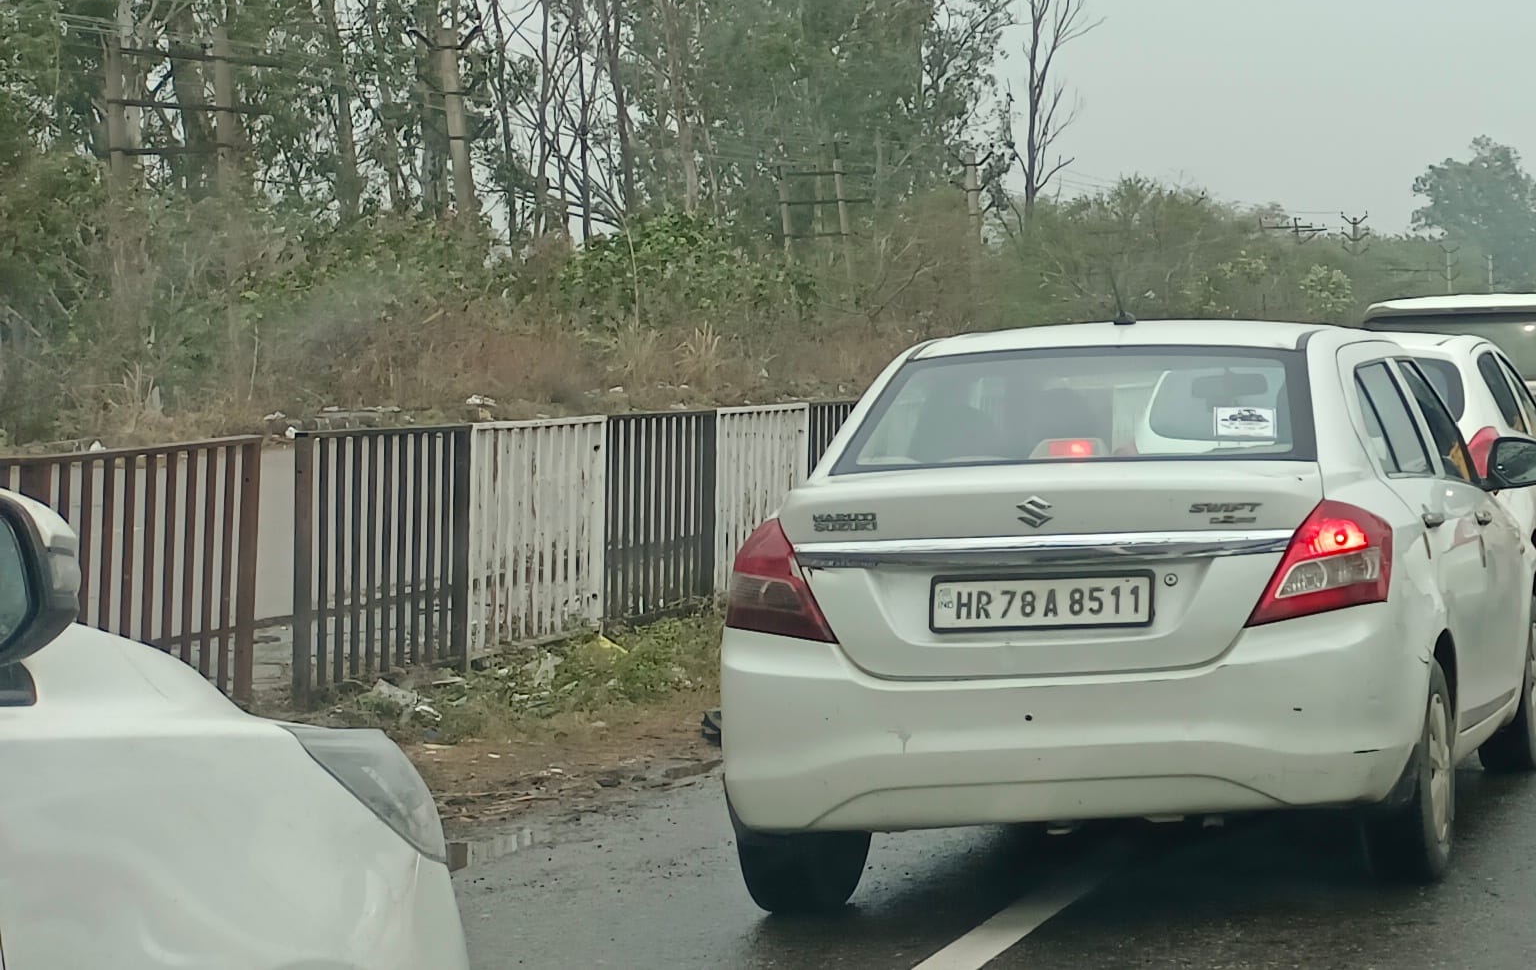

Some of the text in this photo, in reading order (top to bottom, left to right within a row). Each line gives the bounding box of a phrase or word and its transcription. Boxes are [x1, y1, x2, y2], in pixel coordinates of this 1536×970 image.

[1189, 502, 1262, 513] SWIFT
[814, 522, 877, 532] SUZUKI
[955, 585, 1140, 620] HR 78 A 8511
